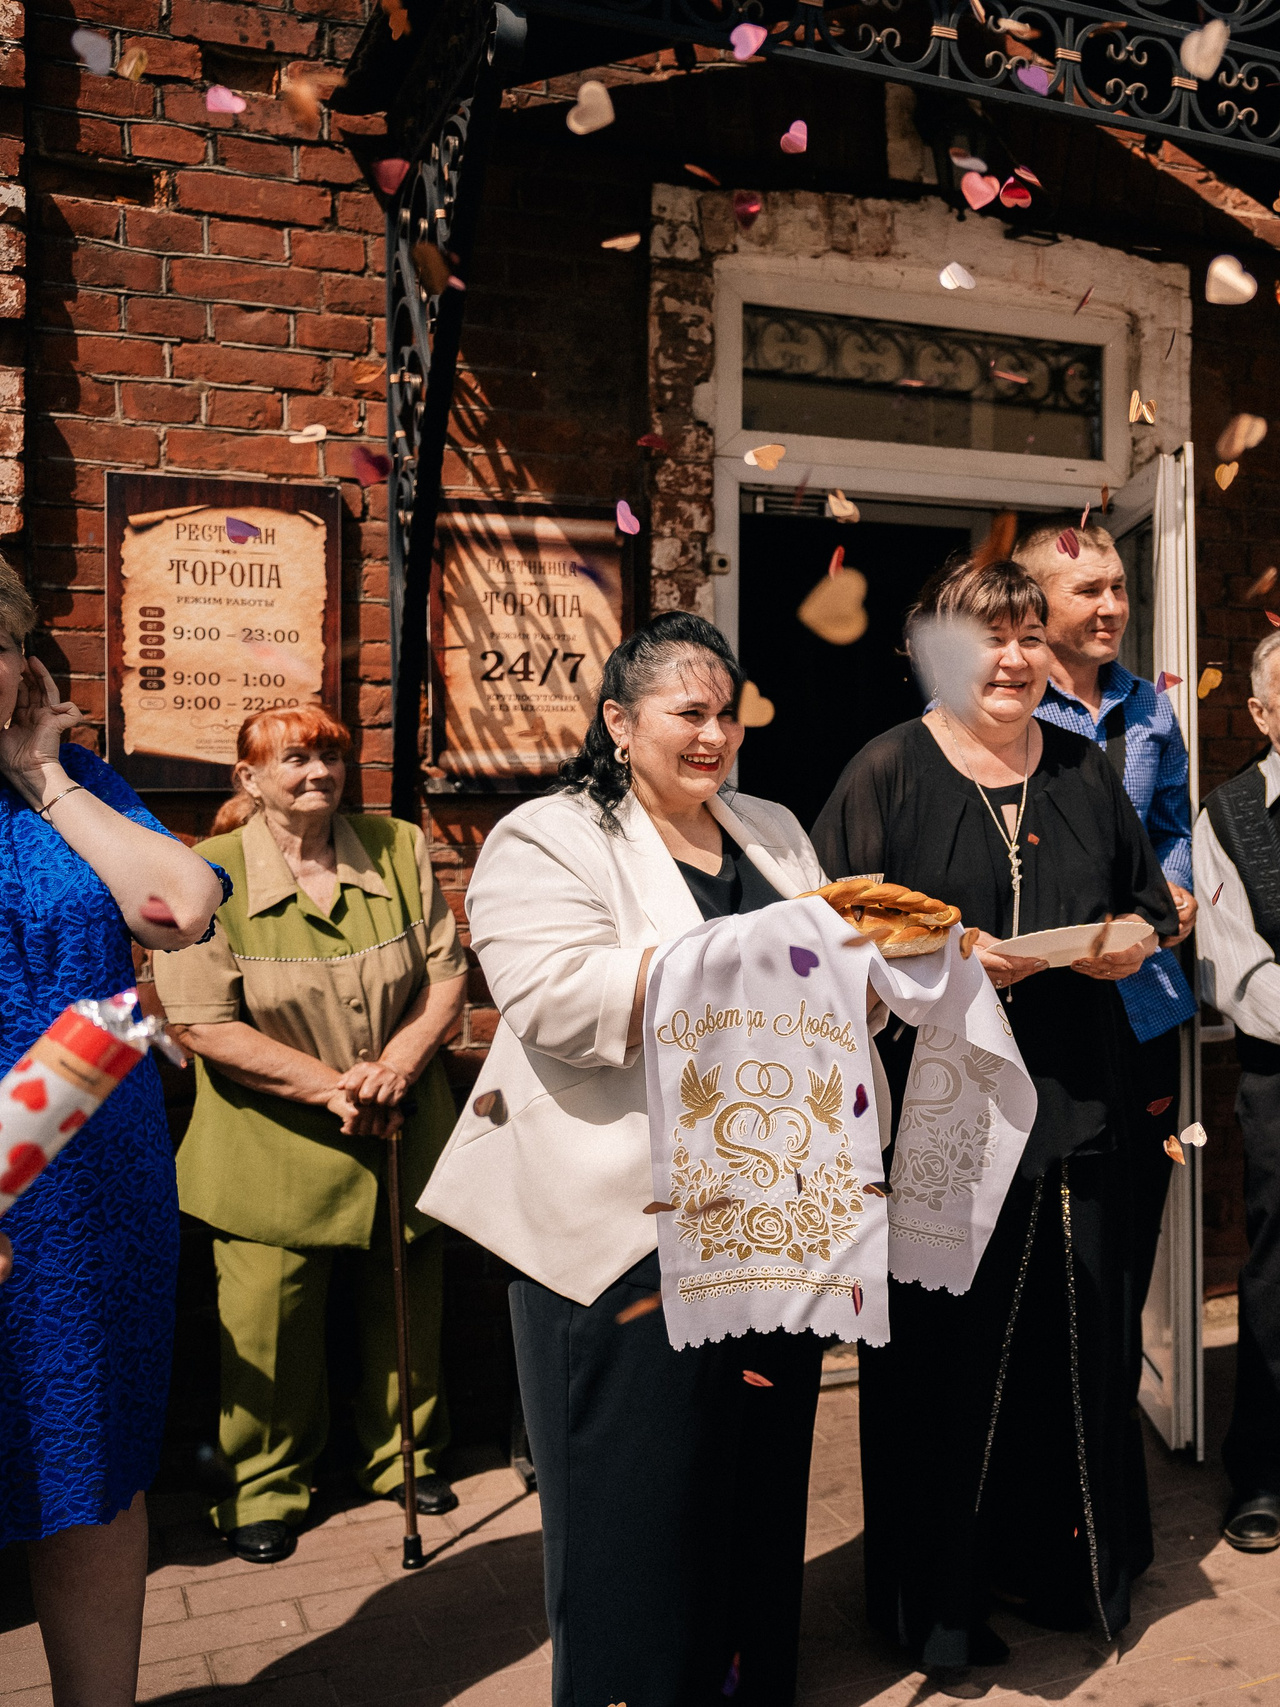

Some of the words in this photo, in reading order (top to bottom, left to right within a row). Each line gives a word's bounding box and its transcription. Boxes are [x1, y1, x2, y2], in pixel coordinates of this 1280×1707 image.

[168, 559, 282, 589] ТОРОПА
[487, 557, 577, 577] ГОСТИНИЦА
[176, 596, 222, 606] РЕЖИМ
[226, 598, 275, 608] РАБОТЫ
[483, 591, 583, 617] ТОРОПА
[173, 626, 220, 641] 9:00
[241, 628, 299, 643] 23:00
[490, 632, 529, 640] РЕЖИМ
[534, 633, 577, 641] РАБОТЫ
[480, 648, 586, 686] 24/7
[173, 671, 221, 686] 9:00
[243, 673, 285, 687] 1:00
[173, 695, 221, 710] 9:00
[656, 1003, 744, 1053] Совет
[772, 999, 857, 1053] Любовь
